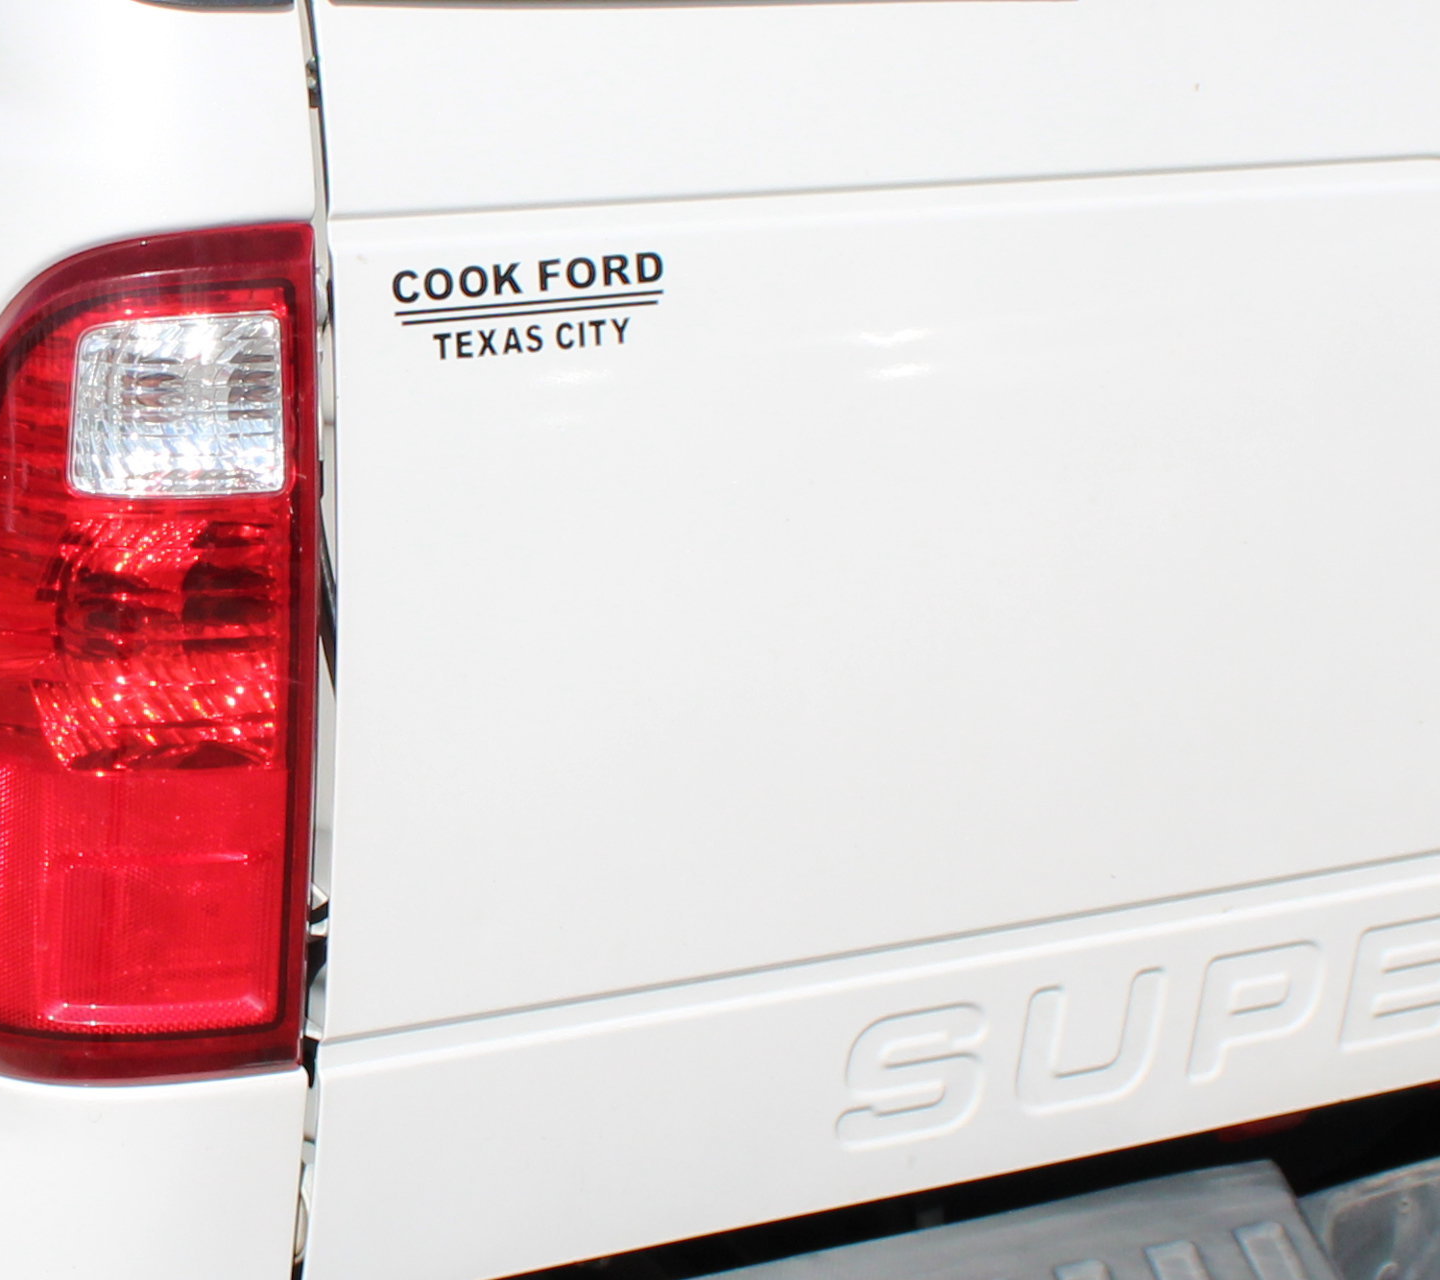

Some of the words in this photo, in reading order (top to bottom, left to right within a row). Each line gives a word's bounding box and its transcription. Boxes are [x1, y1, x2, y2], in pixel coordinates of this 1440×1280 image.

[392, 261, 523, 304] COOK
[538, 251, 664, 291] FORD
[433, 324, 544, 360] TEXAS
[555, 317, 631, 351] CITY
